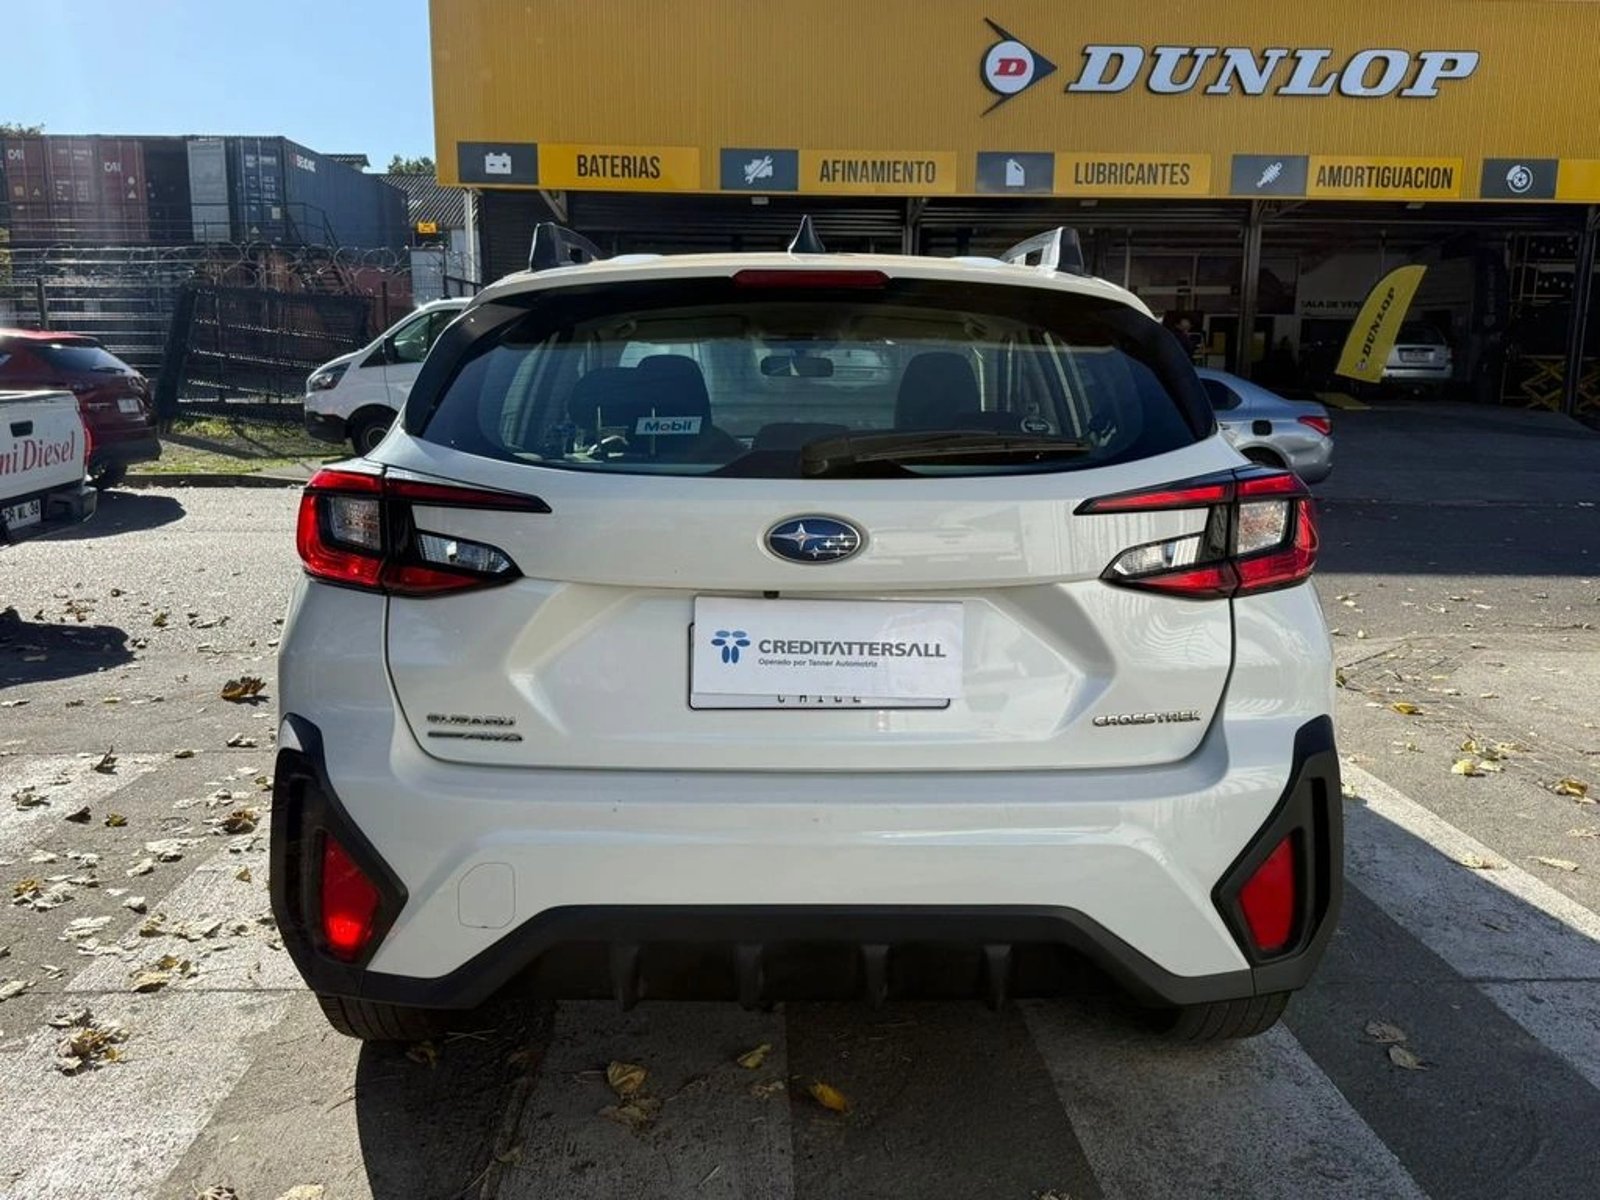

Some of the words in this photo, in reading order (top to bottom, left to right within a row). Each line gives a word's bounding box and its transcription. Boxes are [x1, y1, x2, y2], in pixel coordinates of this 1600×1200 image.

[993, 57, 1028, 77] D
[1065, 44, 1480, 98] DUNLOP
[576, 153, 661, 180] BATERIAS
[819, 159, 936, 184] AFINAMIENTO
[1074, 161, 1191, 187] LUBRICANTES
[1315, 163, 1454, 189] AMORTIGUACION
[1361, 286, 1395, 358] DUNLOP
[644, 420, 692, 432] Mobil
[22, 430, 76, 471] Diesel
[758, 639, 947, 658] CREDITATTERSALL
[758, 657, 792, 668] Operado
[793, 659, 807, 668] por
[808, 659, 834, 668] Tanner
[835, 660, 878, 669] Automotriz
[426, 712, 515, 726] SUBARU
[1091, 710, 1201, 727] CROSSTREK
